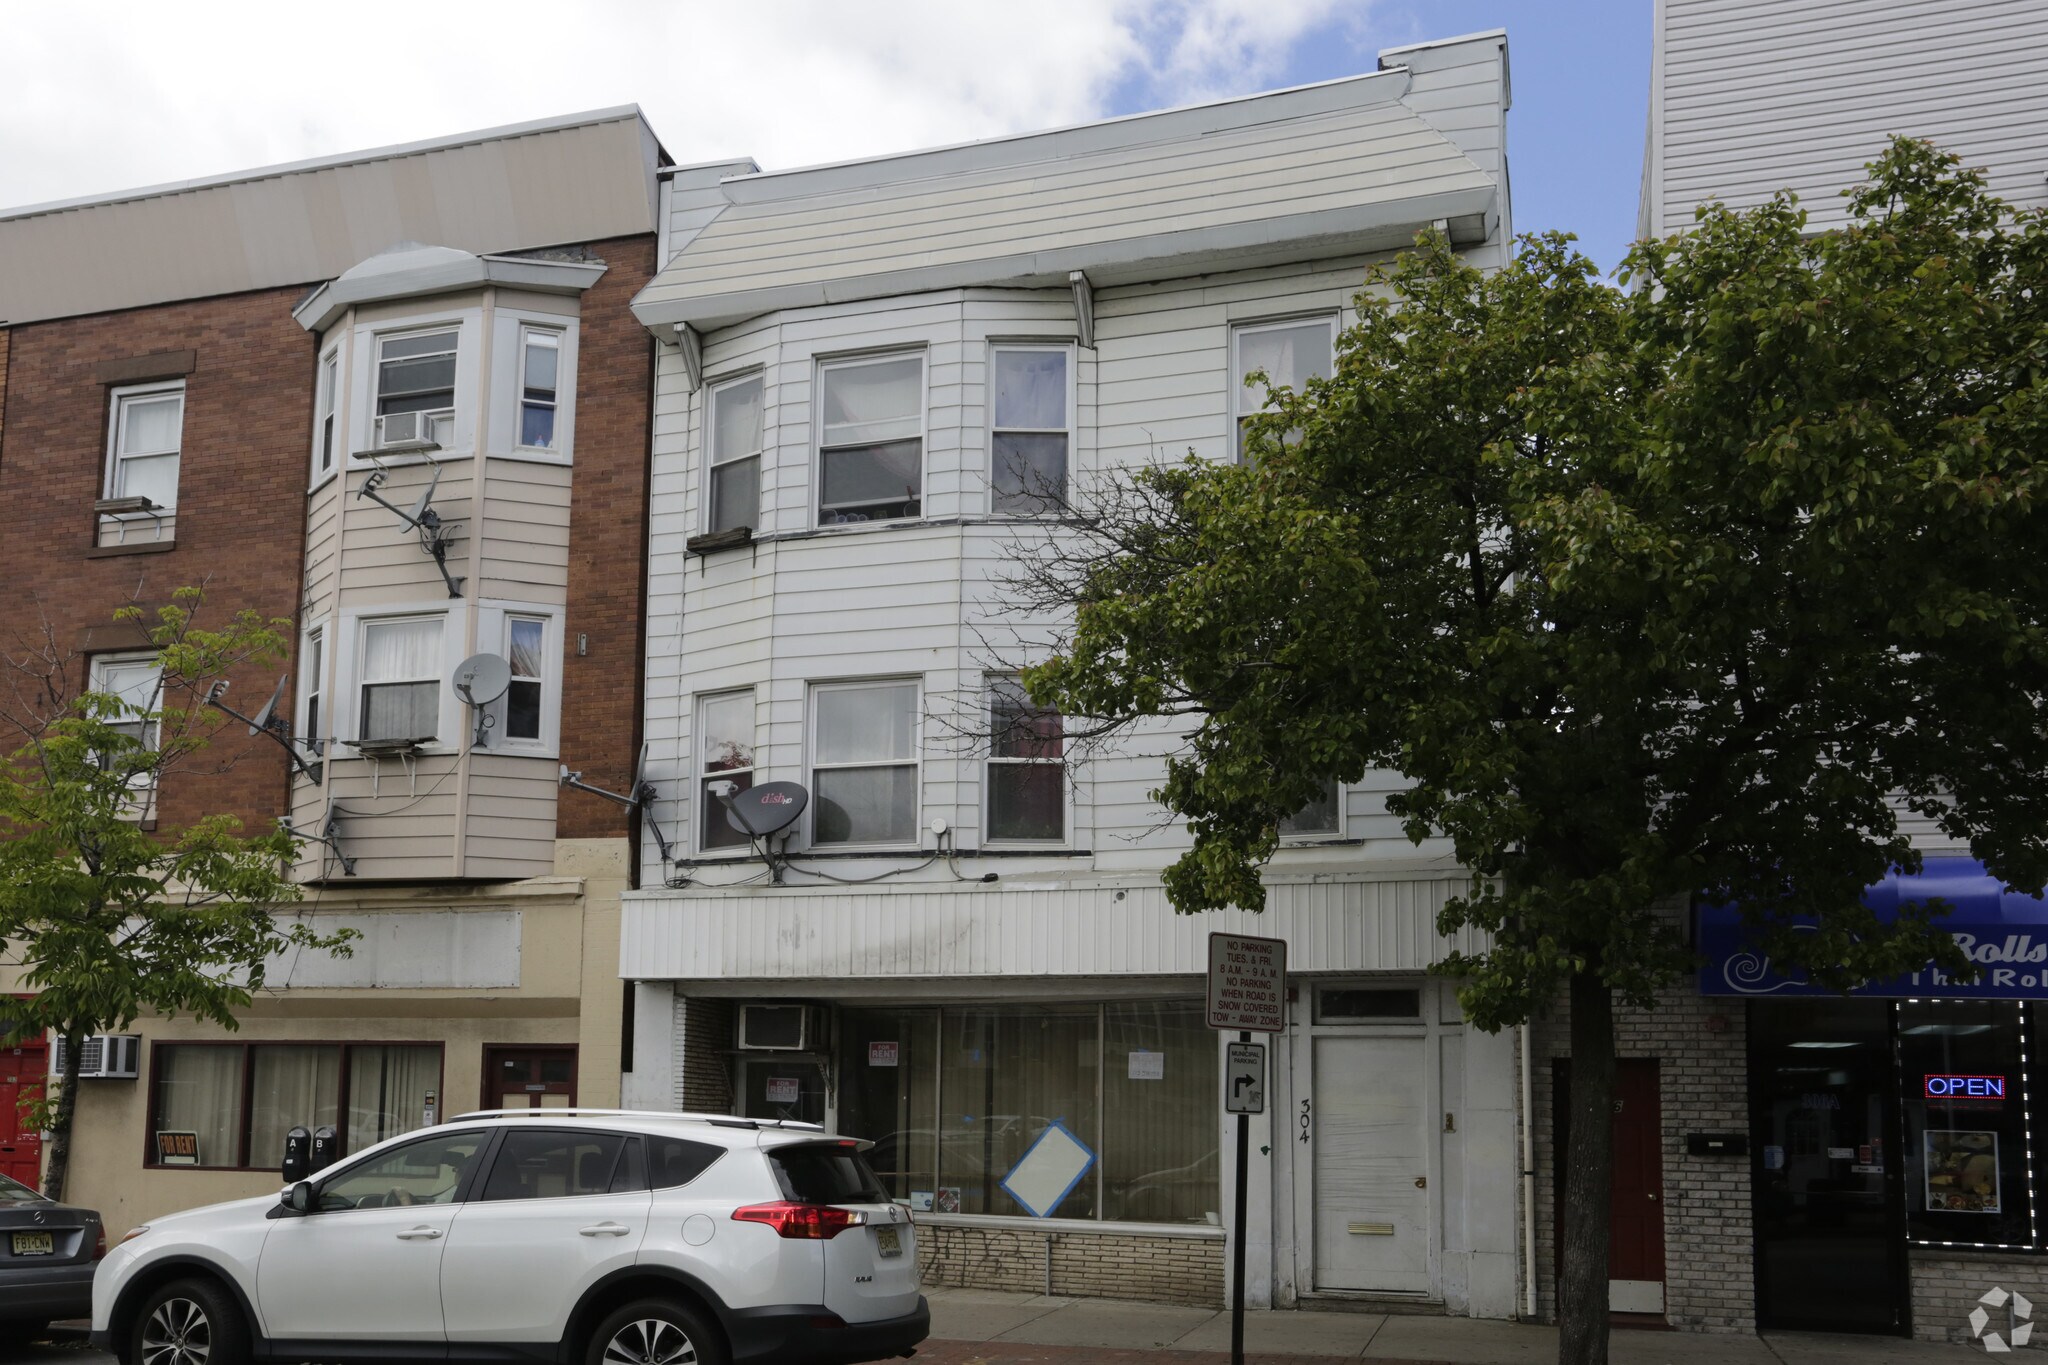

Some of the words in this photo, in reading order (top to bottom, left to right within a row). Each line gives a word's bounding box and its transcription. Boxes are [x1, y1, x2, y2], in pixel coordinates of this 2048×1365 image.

[761, 793, 784, 804] dish
[1227, 941, 1238, 951] NO
[1241, 942, 1273, 955] PARKING
[1227, 953, 1248, 963] TUES.
[1250, 955, 1257, 965] &
[1259, 956, 1272, 967] FRI.
[1220, 965, 1225, 974] 8
[1228, 966, 1243, 975] A.M.
[1252, 968, 1258, 977] 9
[1226, 977, 1238, 987] NO
[1240, 979, 1272, 990] PARKING
[1221, 988, 1243, 999] WHEN
[1246, 990, 1266, 1001] ROAD
[1269, 992, 1276, 1002] IS
[1218, 1001, 1241, 1011] SNOW
[1244, 1003, 1279, 1014] COVERED
[1212, 1012, 1229, 1022] TOW
[1239, 1014, 1258, 1025] AWAY
[1260, 1015, 1280, 1026] ZONE
[872, 1050, 896, 1058] RENT
[1231, 1050, 1260, 1058] MUNICIPAL
[1233, 1057, 1257, 1065] PARKING
[770, 1086, 796, 1094] RENT
[1928, 1077, 2003, 1096] OPEN
[1299, 1098, 1311, 1145] 304
[160, 1135, 175, 1154] FOR
[175, 1135, 195, 1155] RENT
[289, 1139, 297, 1148] A
[316, 1139, 323, 1148] B
